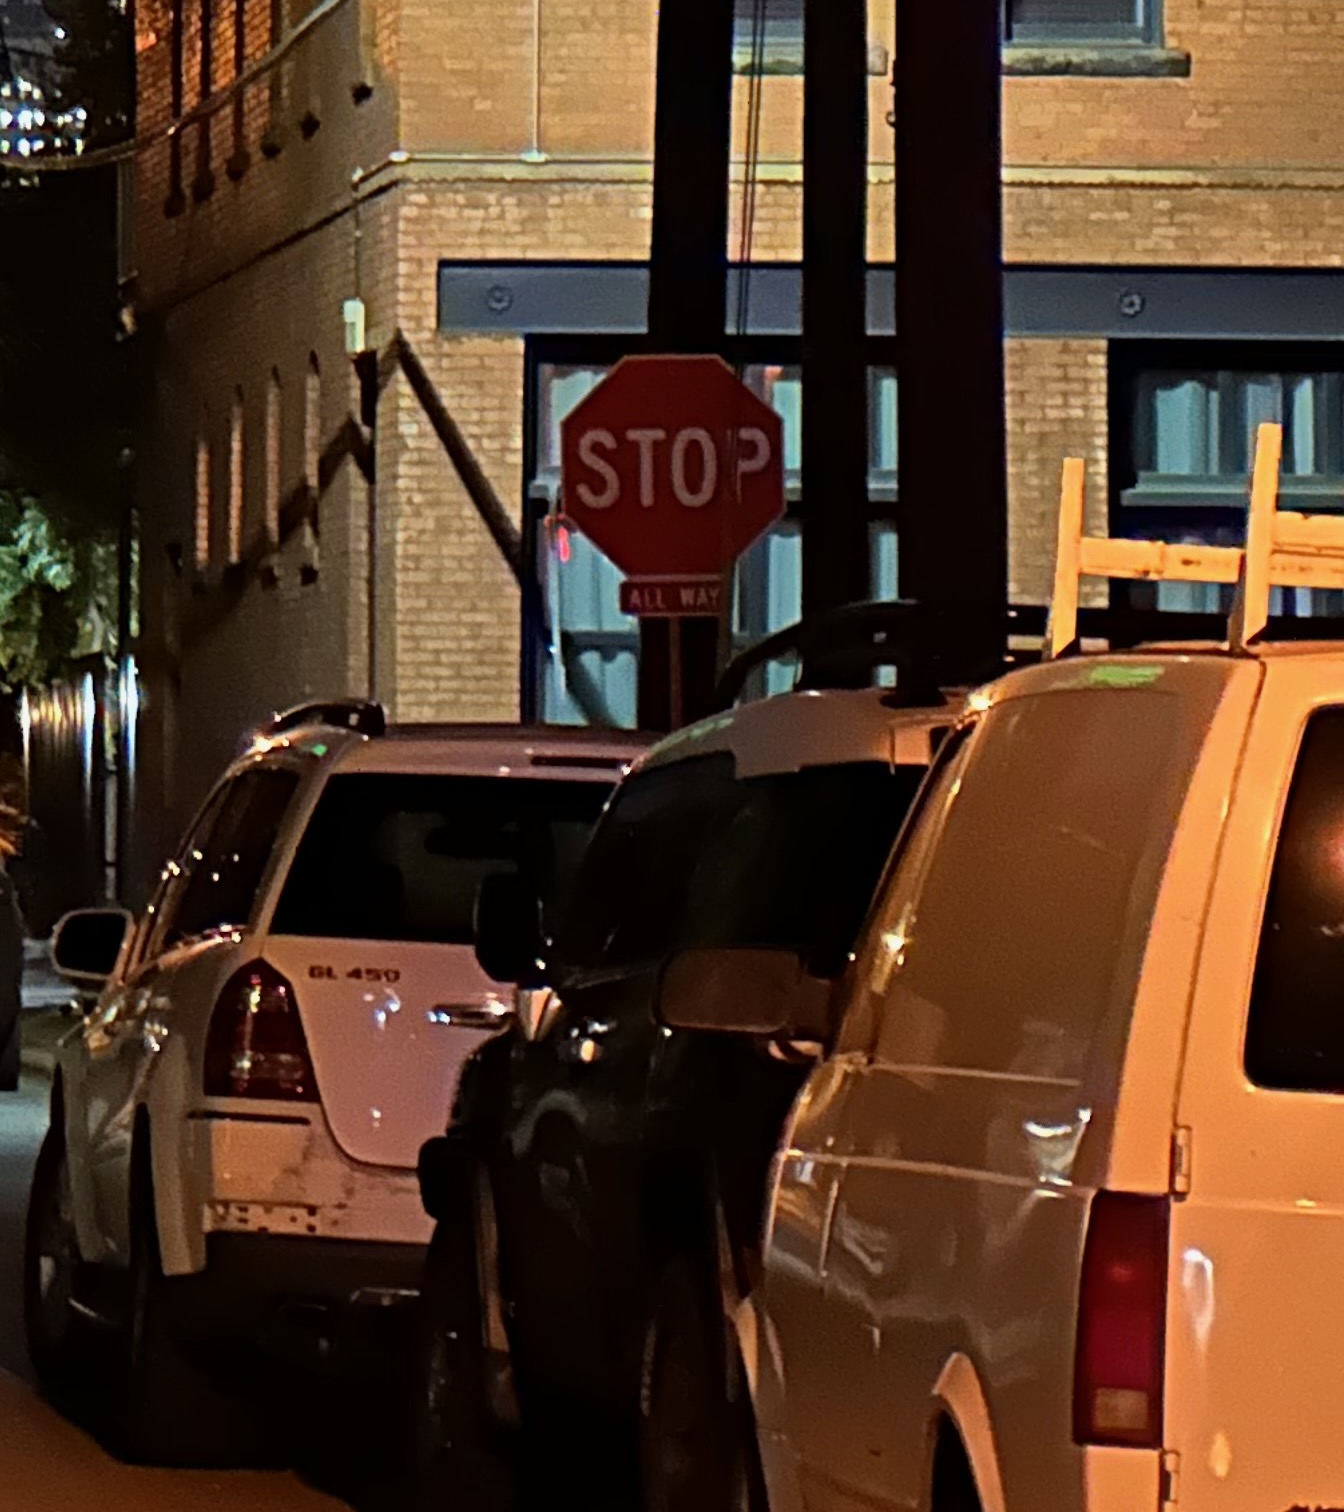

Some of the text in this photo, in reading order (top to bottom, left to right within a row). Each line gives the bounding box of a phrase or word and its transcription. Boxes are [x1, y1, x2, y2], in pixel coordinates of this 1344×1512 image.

[576, 427, 772, 509] STOP
[629, 586, 721, 609] ALL WAY
[308, 964, 402, 984] GL 450
